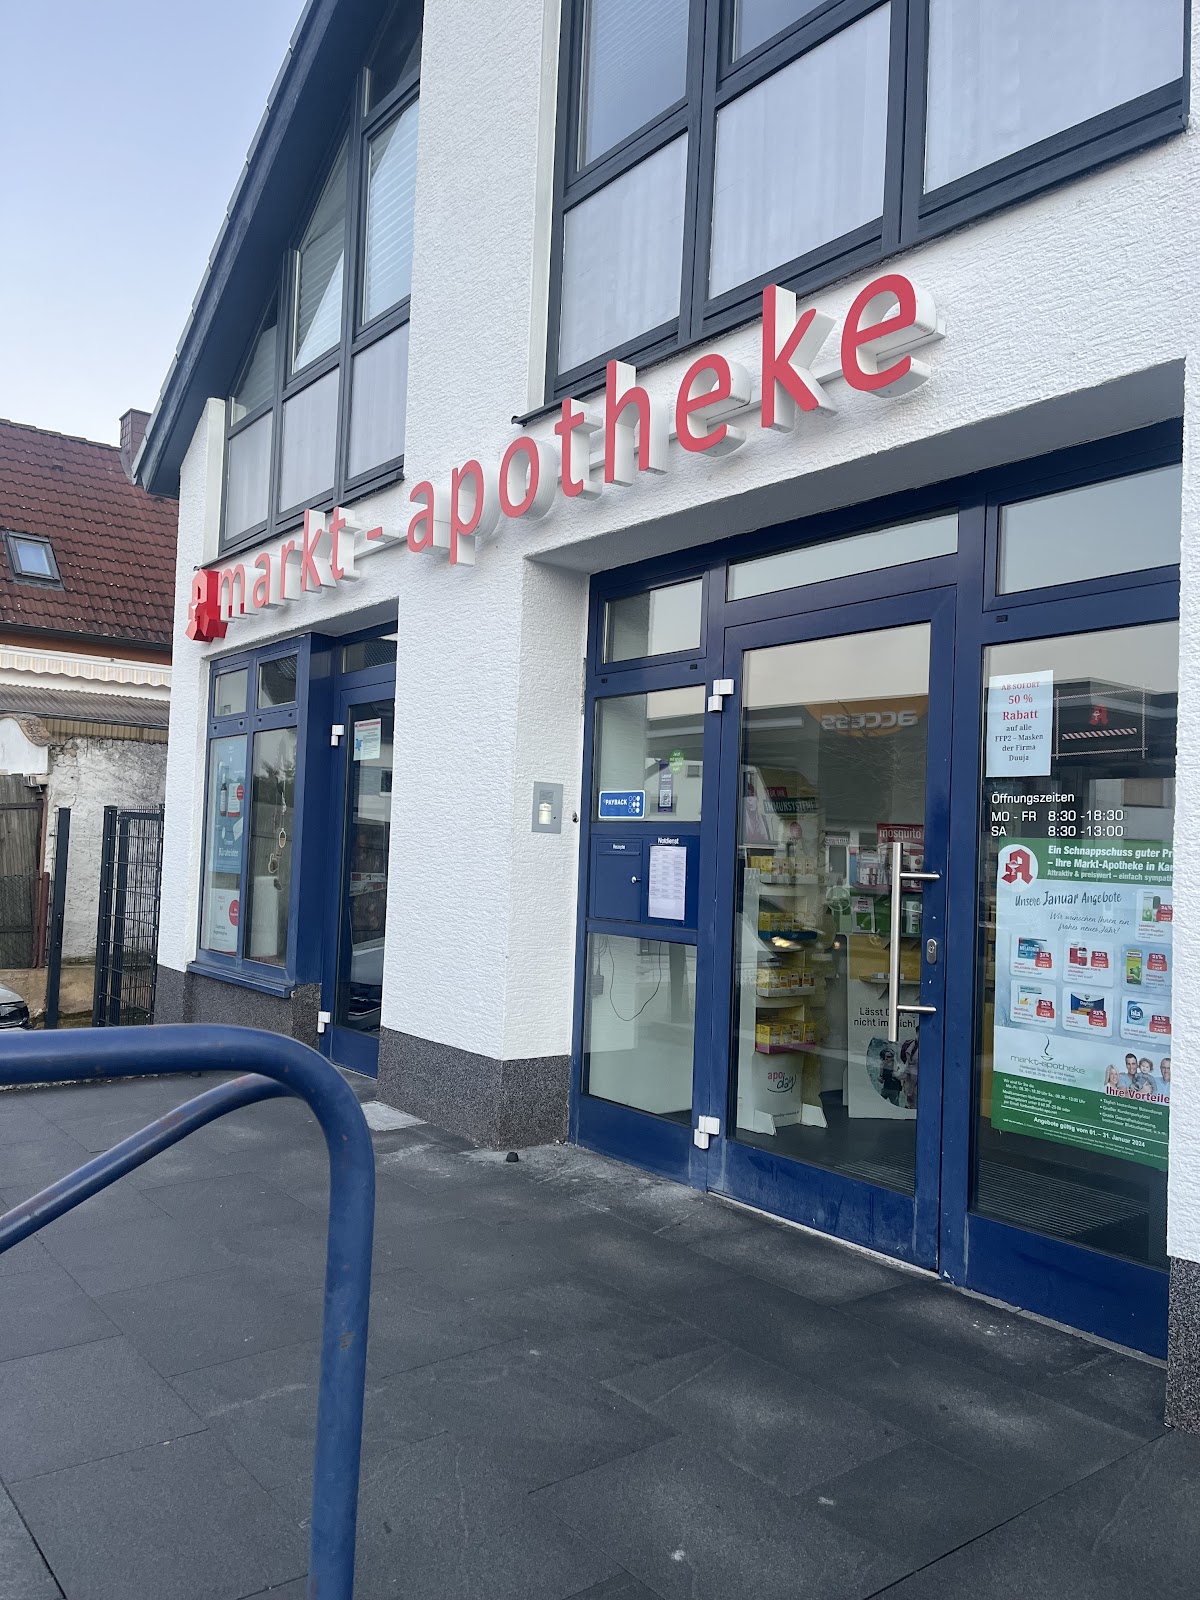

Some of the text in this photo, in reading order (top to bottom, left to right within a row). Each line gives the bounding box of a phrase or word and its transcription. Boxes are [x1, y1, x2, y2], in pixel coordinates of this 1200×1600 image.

[1008, 694, 1033, 705] 50 %
[1002, 709, 1038, 721] Rabatt
[1006, 724, 1018, 732] auf
[995, 735, 1012, 743] FFP2
[1018, 733, 1044, 742] Masken
[1002, 743, 1036, 752] der Firma
[991, 792, 1075, 806] Öffnungszeiten
[991, 811, 1010, 822] MO
[1021, 811, 1037, 821] FR
[1048, 810, 1077, 822] 8:30
[879, 828, 922, 841] mosquito
[991, 827, 1007, 837] SA
[1048, 826, 1077, 837] 8:30
[657, 837, 680, 845] Notdienst
[1048, 846, 1062, 854] Ein
[1063, 846, 1133, 858] Schnappschuss
[1135, 849, 1160, 859] guter
[1055, 860, 1072, 868] Ihre
[1073, 860, 1144, 872] Markt-Apotheke
[1146, 862, 1155, 871] in
[1081, 871, 1112, 880] preiswert
[1118, 873, 1143, 881] einfach
[1015, 891, 1123, 907] Unsere Januar Angebote
[1050, 912, 1063, 921] Wir
[1098, 915, 1117, 925] Ihnen
[859, 1007, 883, 1016] Lässt
[853, 1018, 877, 1027] nicht
[1010, 1054, 1086, 1075] markt-apotheke
[1106, 1086, 1170, 1104] Ihre Vorteile
[1033, 1116, 1059, 1128] Angebote
[1059, 1121, 1076, 1133] gültig
[1076, 1126, 1089, 1134] vom
[1112, 1134, 1131, 1144] Januar
[1132, 1138, 1146, 1148] 2024
